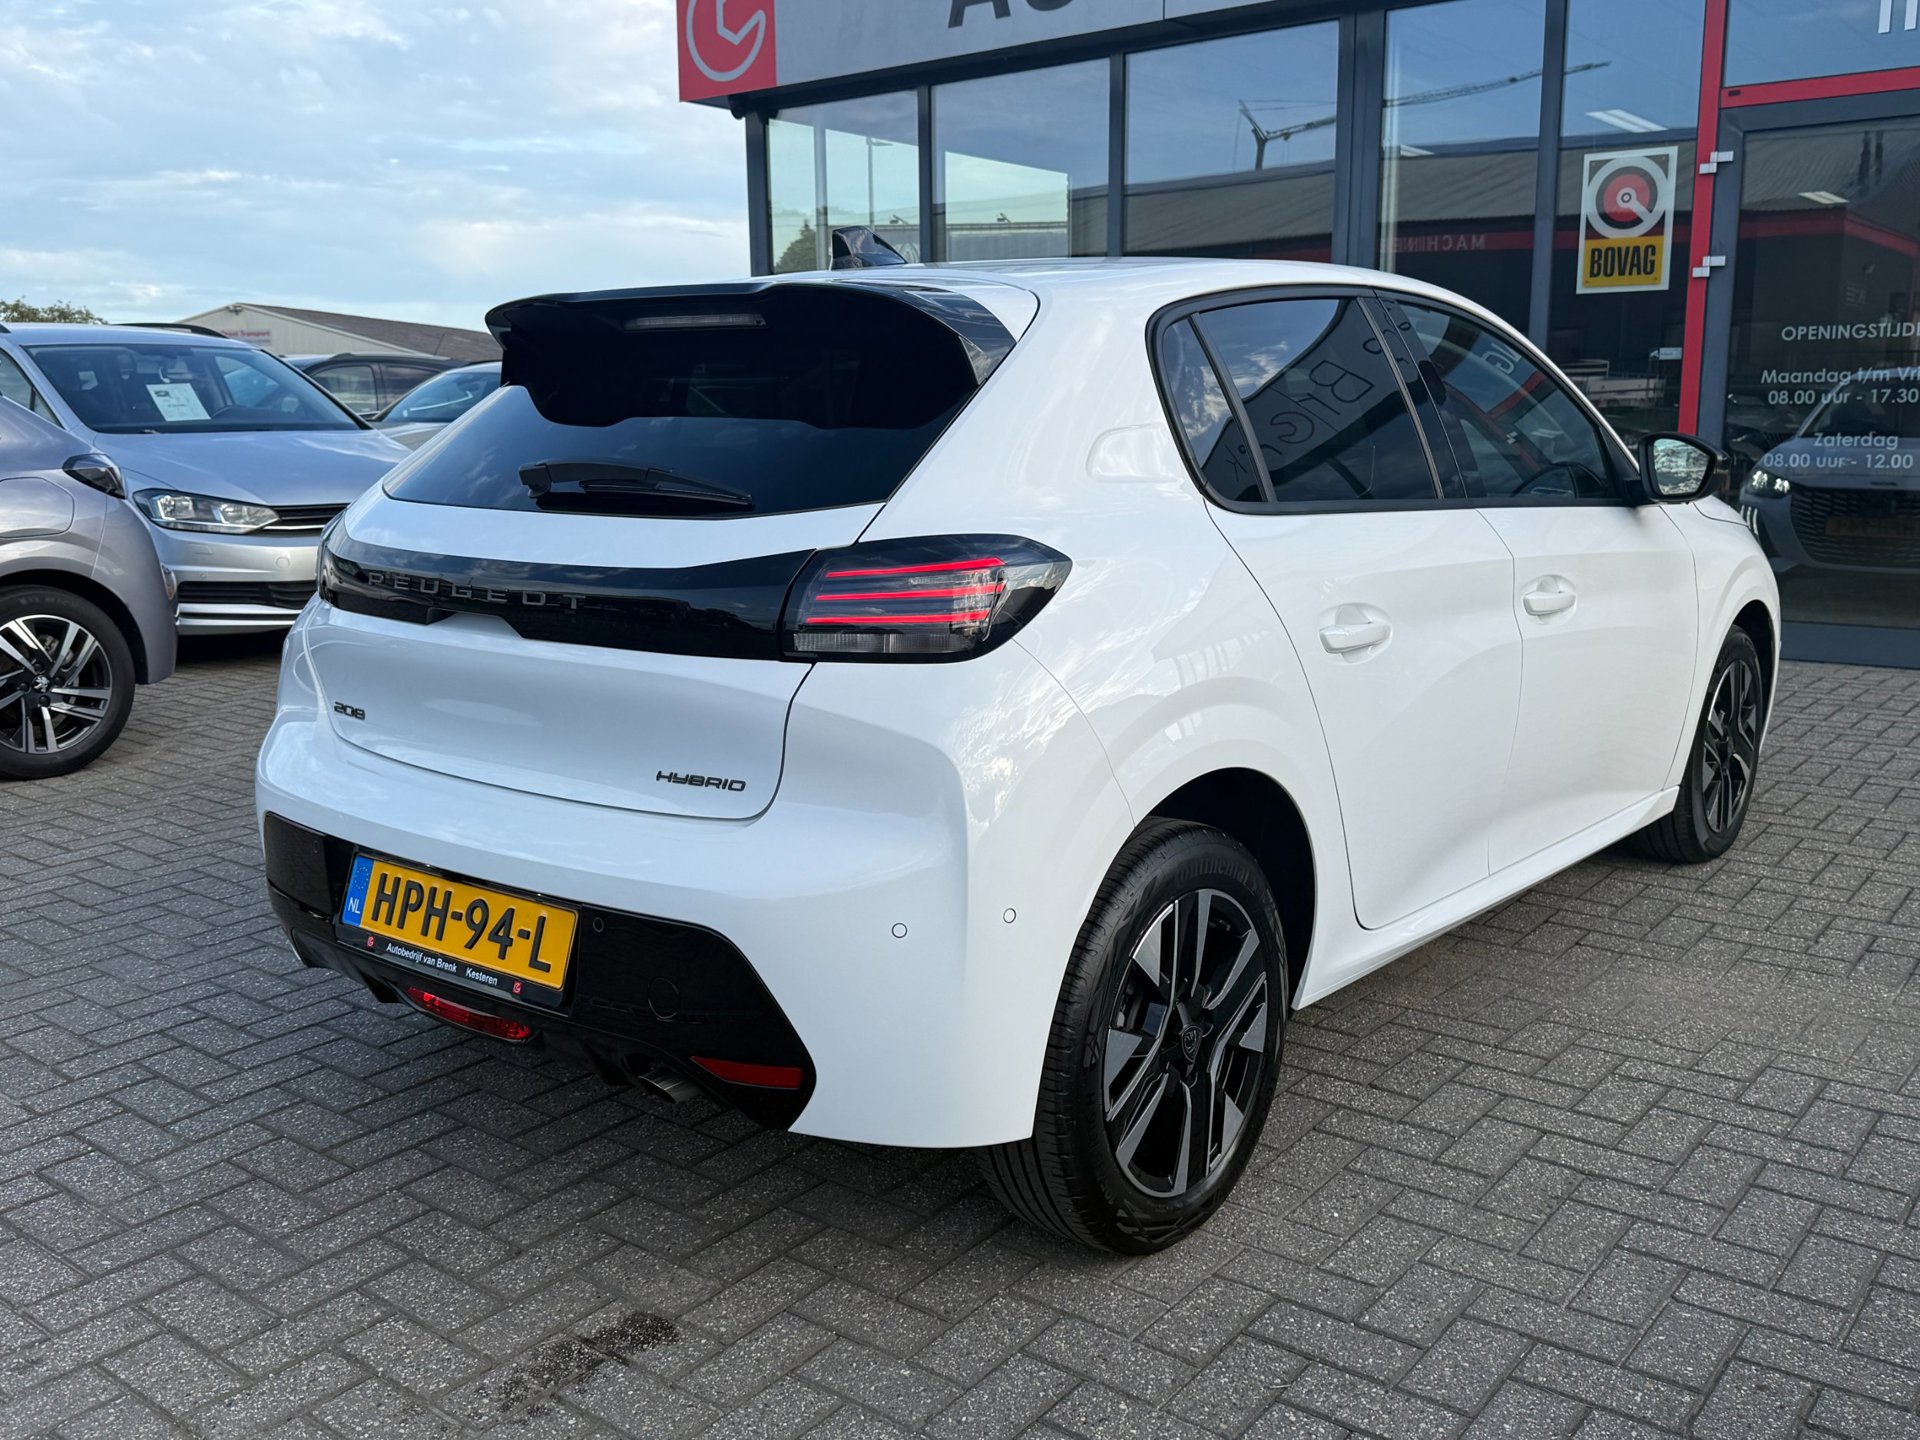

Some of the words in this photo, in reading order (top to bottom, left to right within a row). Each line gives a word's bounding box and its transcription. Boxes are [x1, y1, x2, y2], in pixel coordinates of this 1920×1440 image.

[1589, 244, 1657, 278] BOVAG
[1761, 368, 1851, 385] Maandag
[1858, 367, 1890, 384] t/m
[1768, 389, 1815, 405] 08.00
[1821, 391, 1850, 405] uur
[1870, 388, 1919, 405] 17.30
[1813, 431, 1899, 450] Zaterdag
[1763, 453, 1811, 468] 08.00
[1864, 454, 1914, 469] 12.00
[368, 572, 586, 611] PEUGEOT
[333, 701, 366, 720] 208
[655, 770, 747, 792] HYBRID
[348, 896, 361, 915] NL
[371, 872, 552, 974] HPH-94-L
[385, 942, 424, 964] Autobedrijf
[423, 954, 436, 967] van
[436, 957, 458, 973] Brenk
[465, 966, 499, 986] Kesteren
